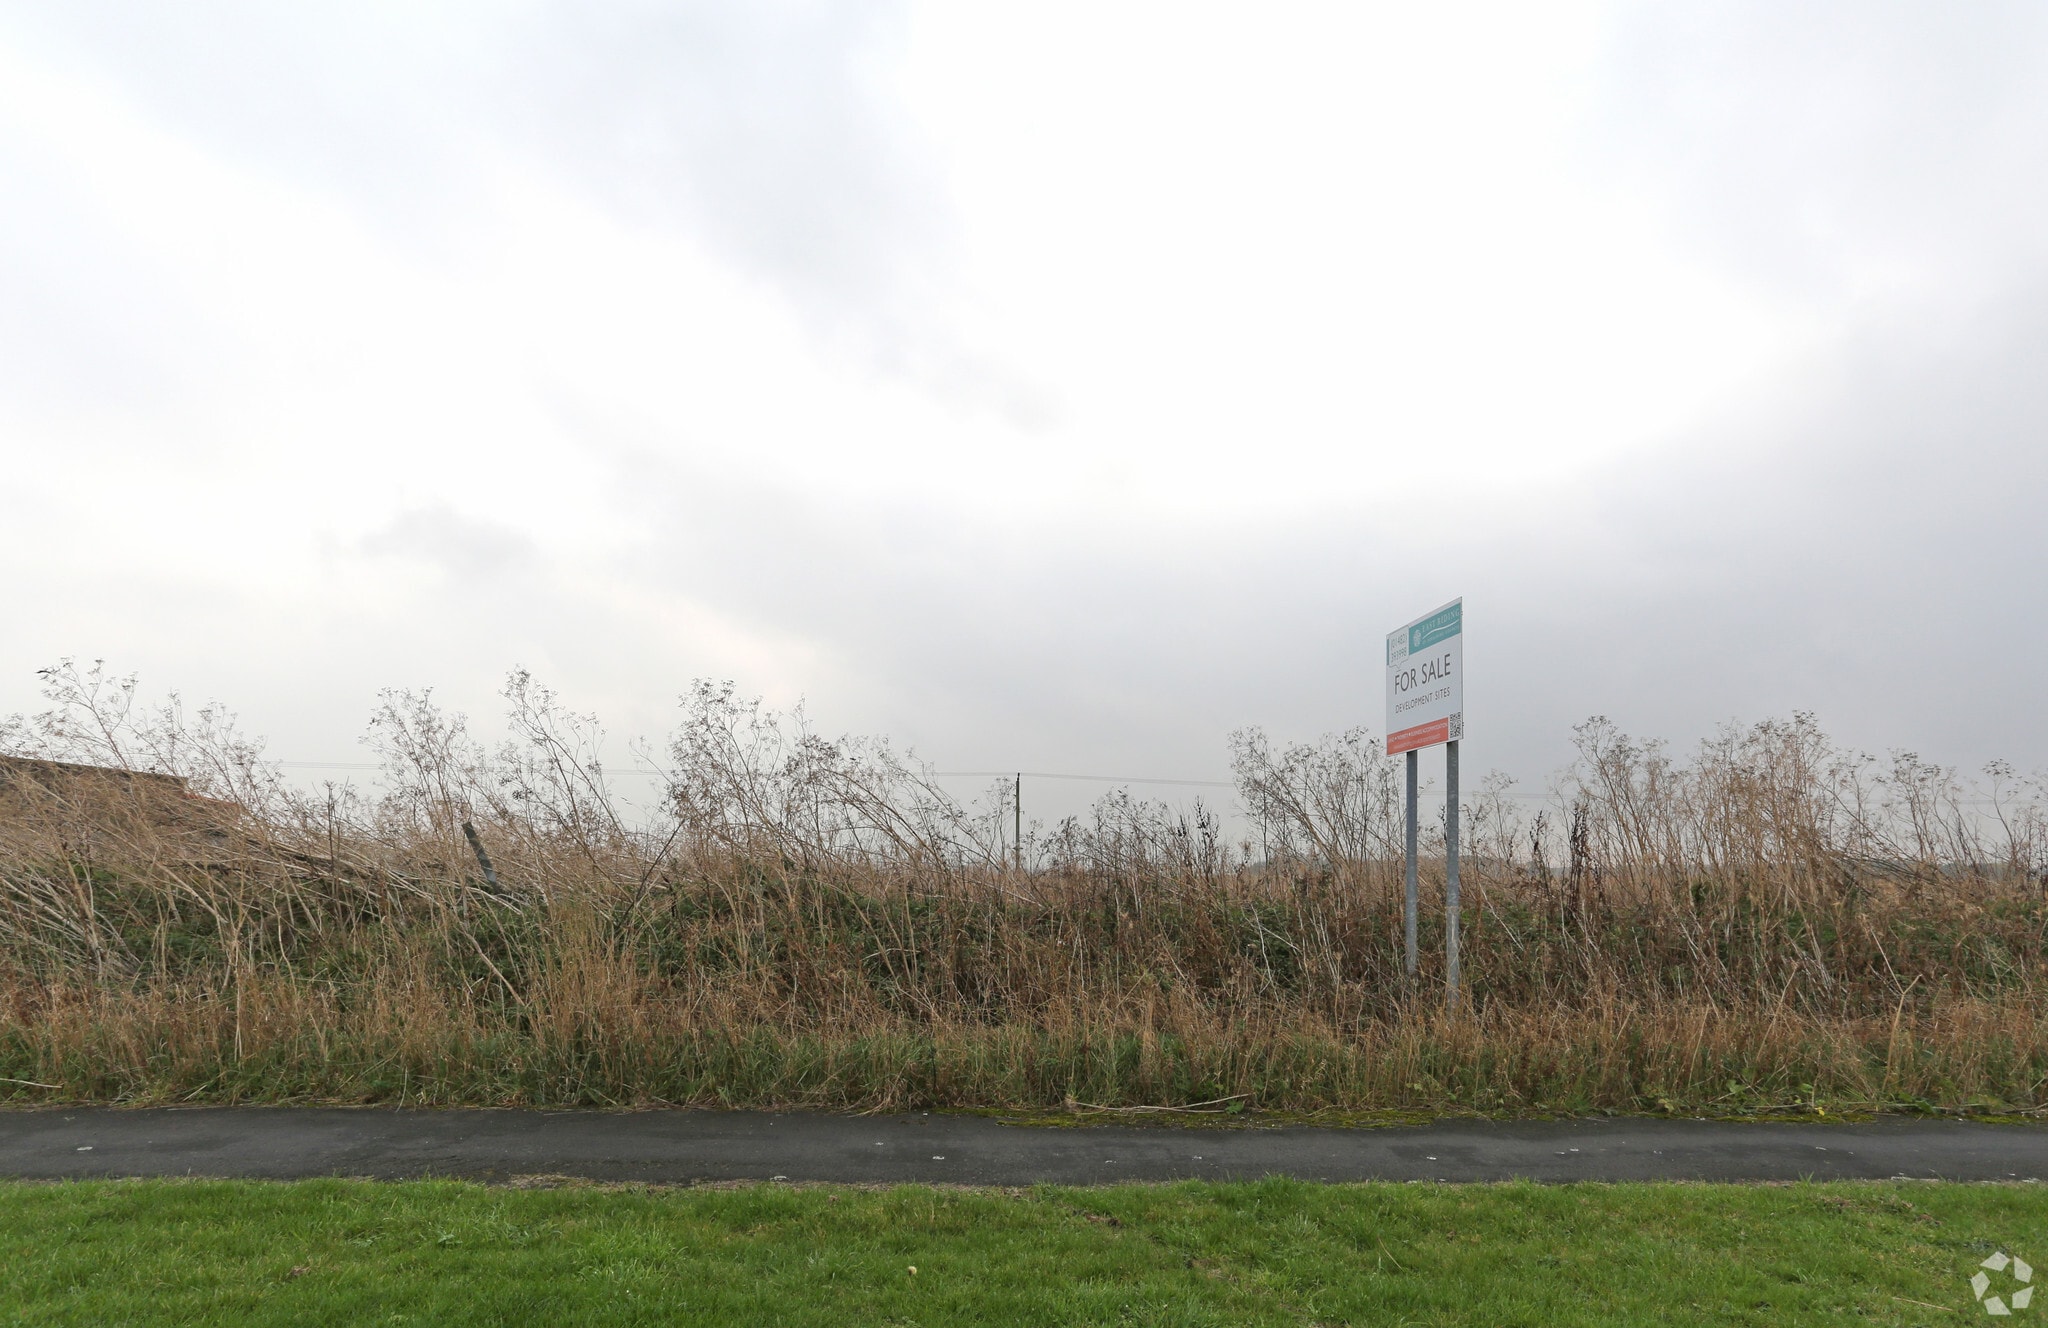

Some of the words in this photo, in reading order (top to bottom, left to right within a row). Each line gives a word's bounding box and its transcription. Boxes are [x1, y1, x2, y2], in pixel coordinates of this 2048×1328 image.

[1438, 608, 1460, 625] RIDING
[1395, 668, 1417, 695] FOR
[1422, 653, 1450, 684] SALE
[1395, 692, 1433, 714] DEVELOPMENT
[1435, 686, 1451, 700] SITES
